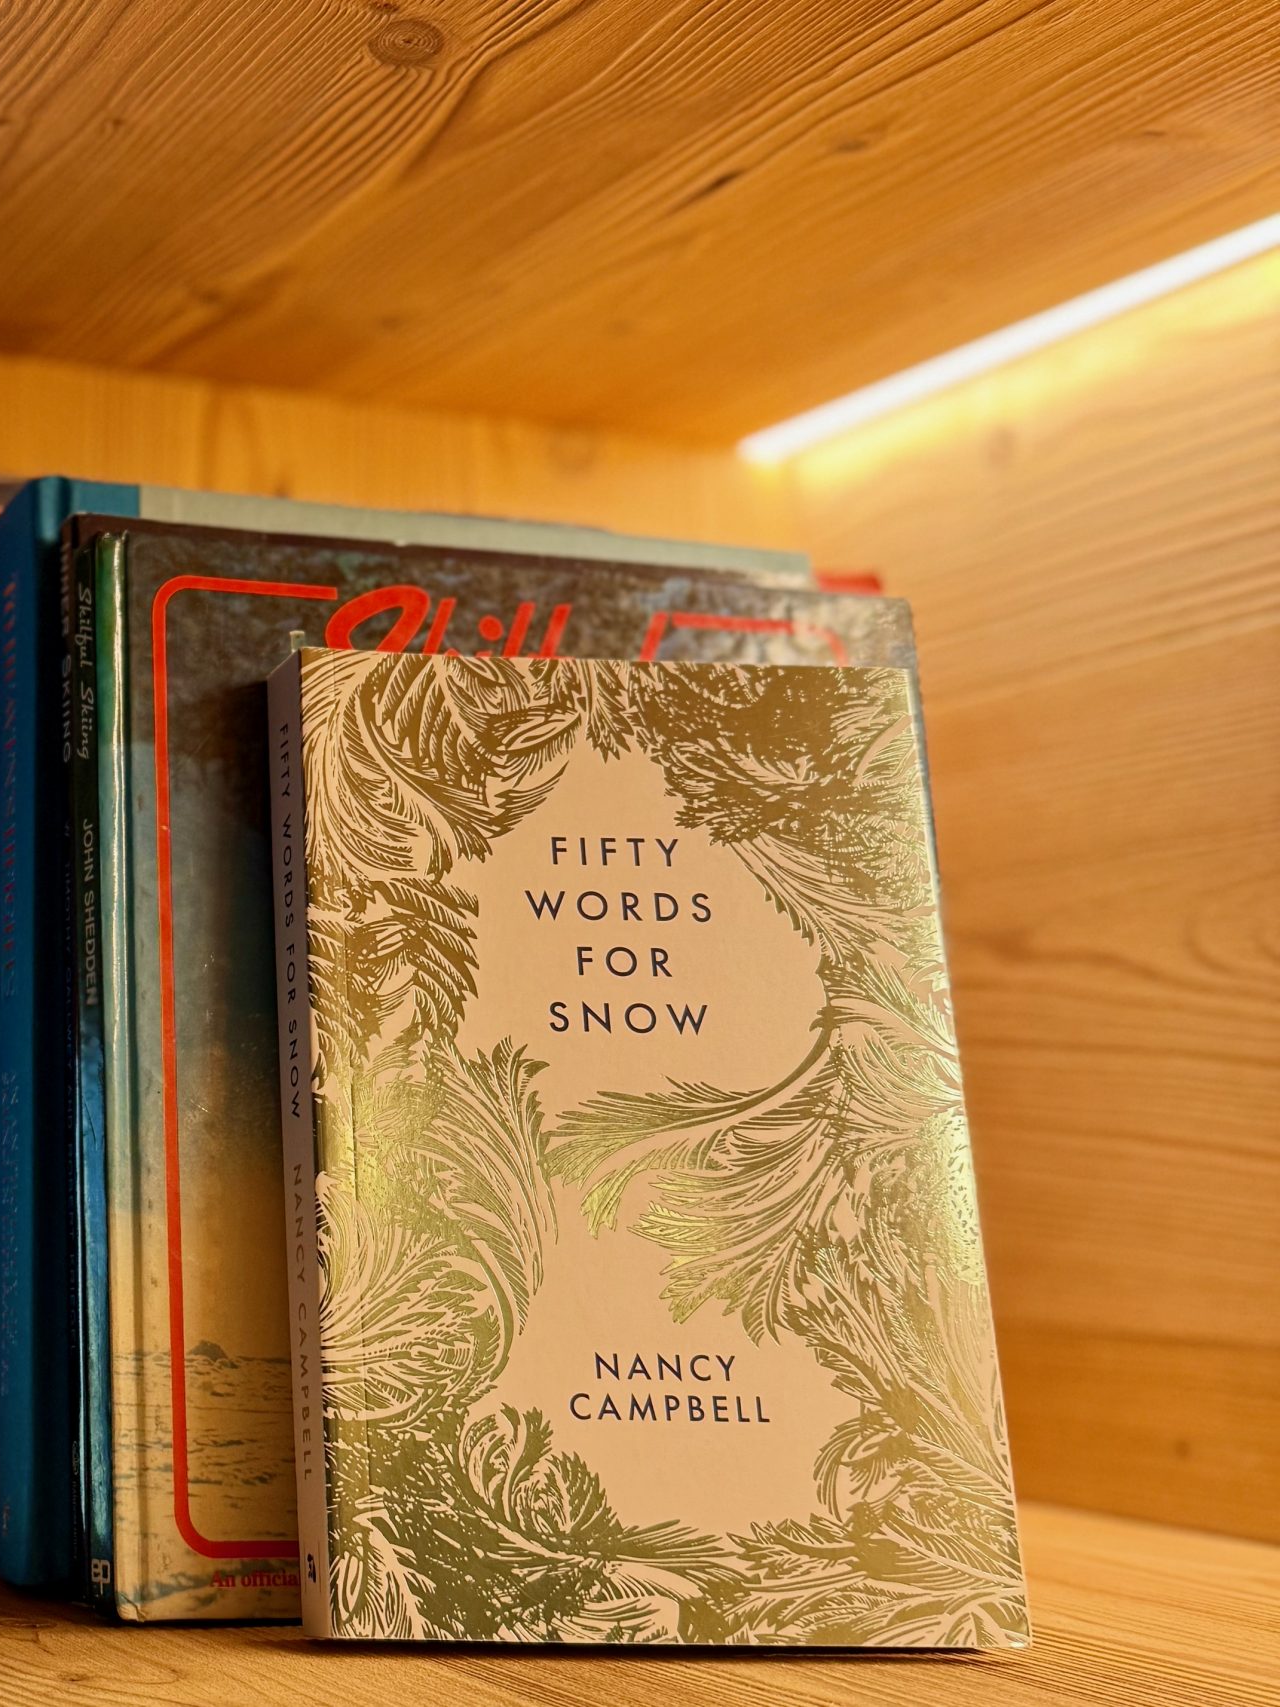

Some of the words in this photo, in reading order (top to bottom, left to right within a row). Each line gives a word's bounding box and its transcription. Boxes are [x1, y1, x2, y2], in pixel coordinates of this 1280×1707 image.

[74, 583, 93, 667] Skilful
[61, 653, 71, 763] SKIING
[77, 681, 94, 759] Skiing
[279, 722, 291, 798] FIFTY
[82, 818, 95, 883] JOHN
[282, 813, 295, 928] WORDS
[551, 836, 679, 867] FIFTY
[524, 889, 712, 923] WORDS
[83, 889, 99, 1006] SHEDDEN
[286, 943, 296, 1004] FOR
[576, 946, 673, 977] FOR
[549, 1000, 708, 1035] SNOW
[288, 1019, 301, 1118] SNOW
[293, 1163, 306, 1284] NANCY
[297, 1301, 311, 1481] CAMPBELL
[594, 1351, 736, 1382] NANCY
[569, 1392, 770, 1423] CAMPBELL
[210, 1569, 236, 1587] An
[240, 1568, 300, 1587] officia
